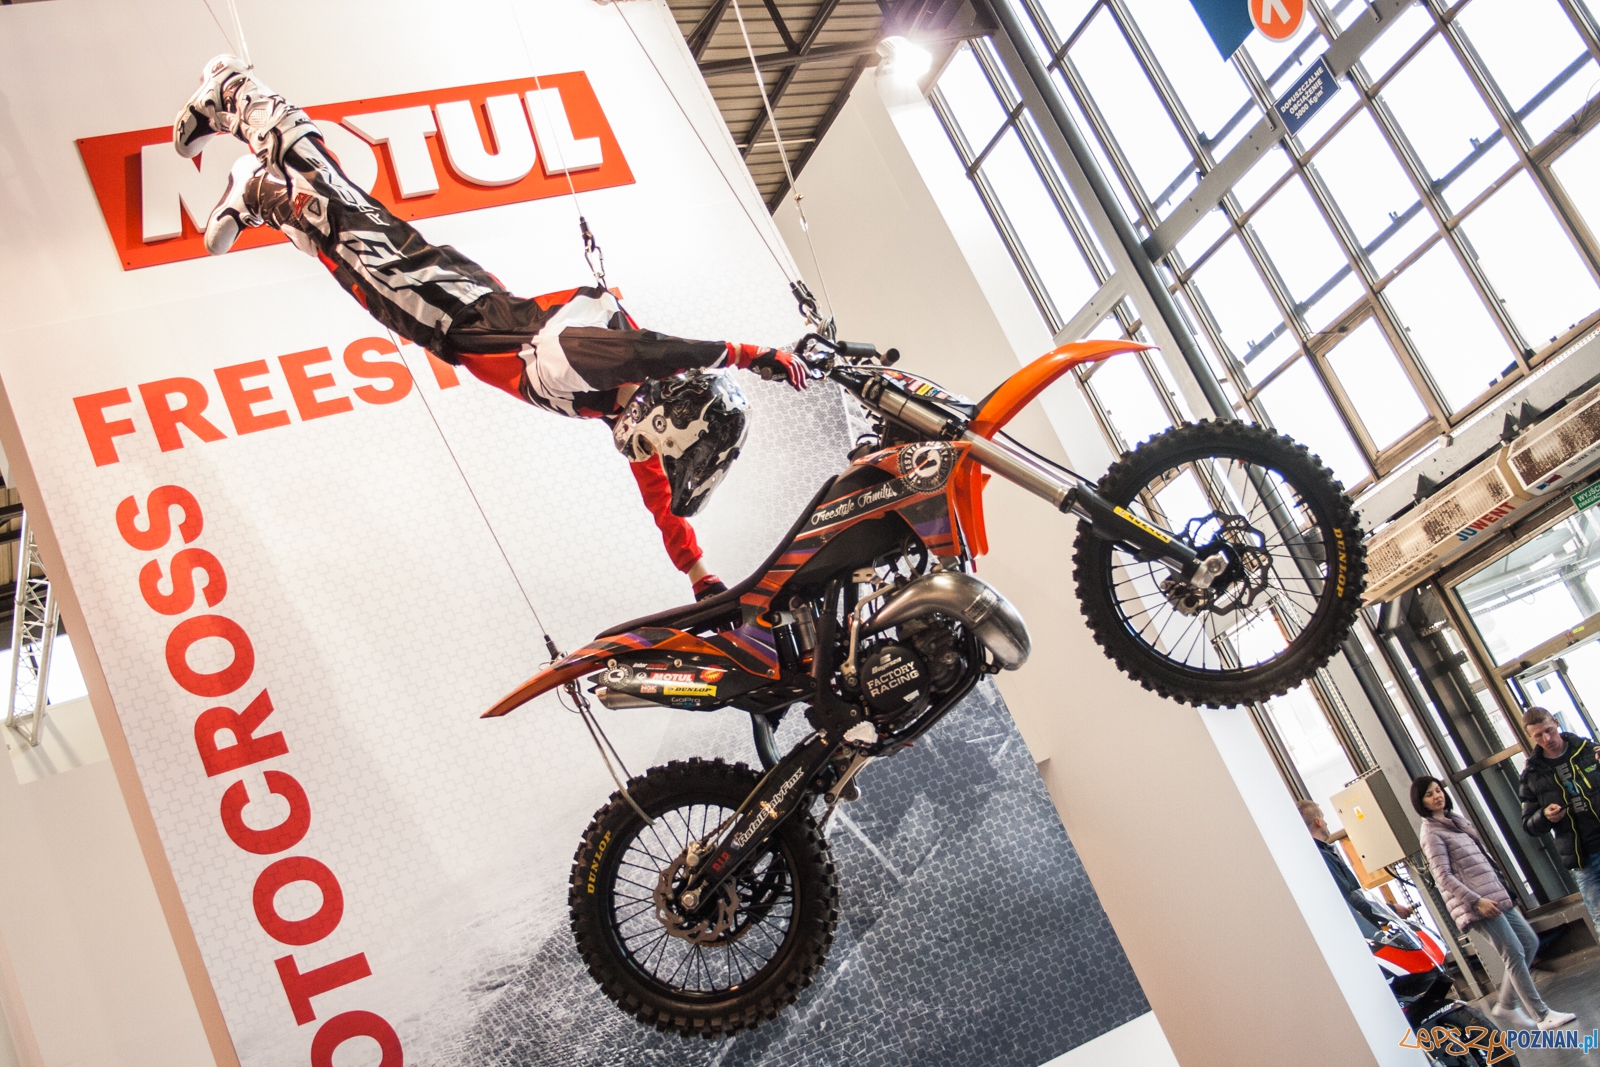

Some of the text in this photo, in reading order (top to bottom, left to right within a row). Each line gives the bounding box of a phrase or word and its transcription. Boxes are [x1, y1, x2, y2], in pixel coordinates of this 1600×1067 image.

[1280, 66, 1324, 113] DOPUSZCZALNE
[1289, 78, 1323, 115] OBCIĄŻENIE
[1294, 104, 1310, 120] 3000
[811, 498, 855, 525] Freestyle
[1455, 502, 1517, 542] JUWENT
[1332, 527, 1346, 598] DUNLOP
[651, 672, 692, 682] MOTUL
[866, 661, 915, 690] FACTORY
[870, 669, 920, 698] RACING
[587, 830, 612, 895] DUNLOP
